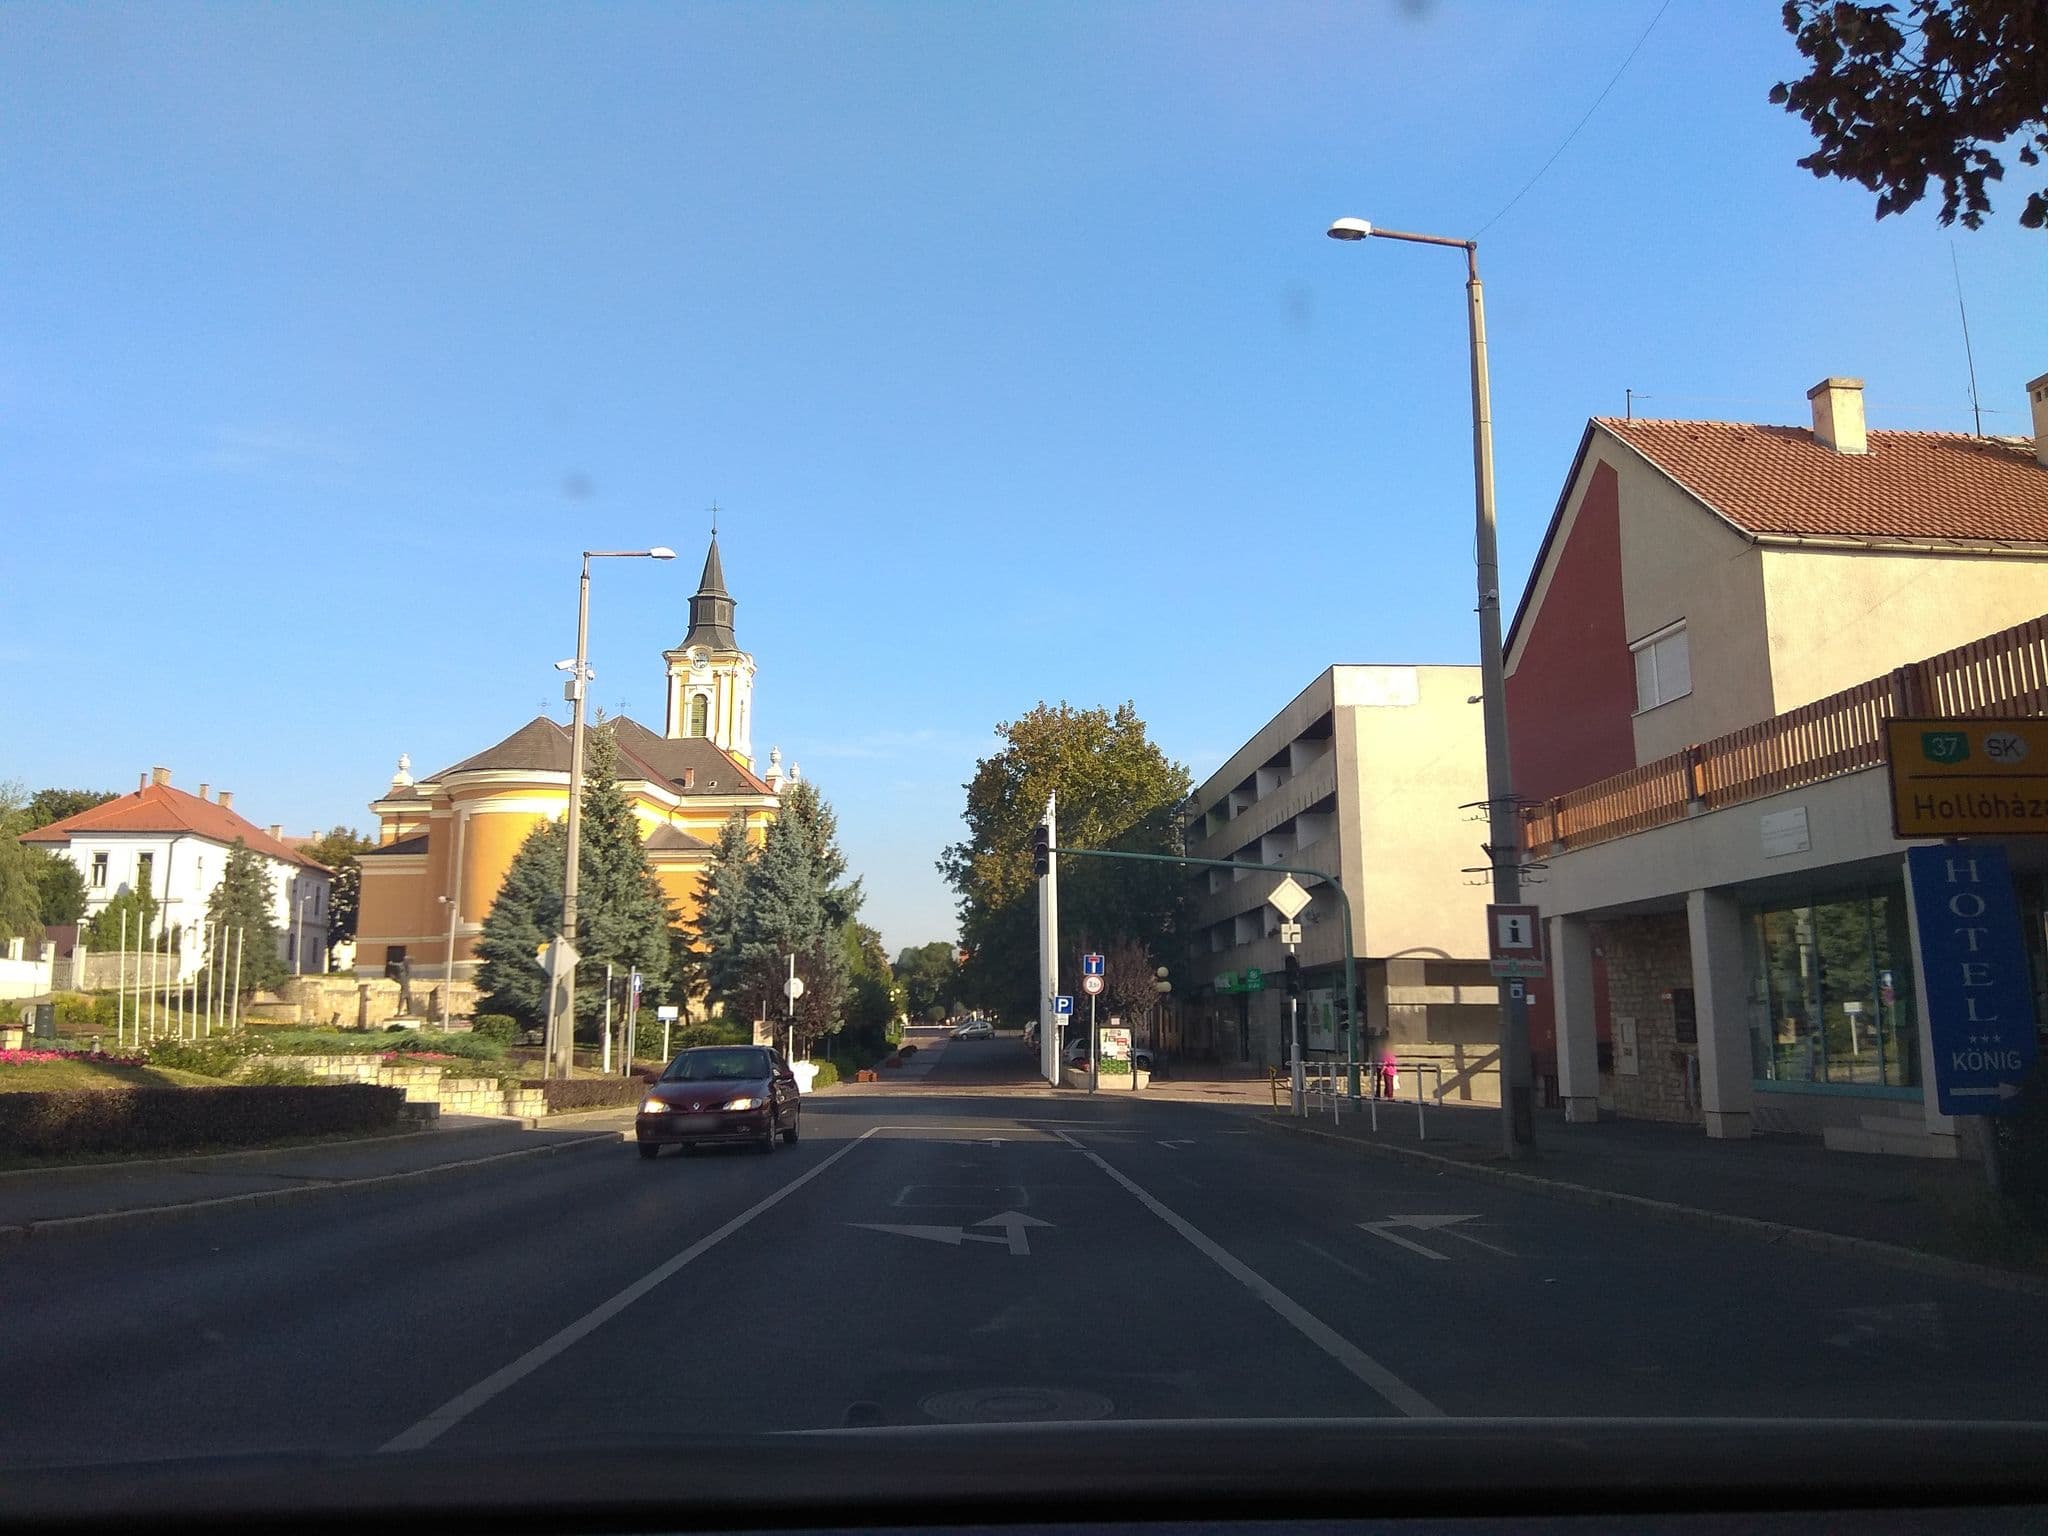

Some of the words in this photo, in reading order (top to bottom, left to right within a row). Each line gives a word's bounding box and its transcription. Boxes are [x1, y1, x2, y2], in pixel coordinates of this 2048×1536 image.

[1931, 736, 1958, 756] 37
[1987, 738, 2020, 757] SK
[1914, 793, 2048, 820] Hollóház
[1945, 858, 1999, 1023] HOTEL
[1058, 999, 1069, 1013] P
[1952, 1047, 2023, 1072] KÖNIG
